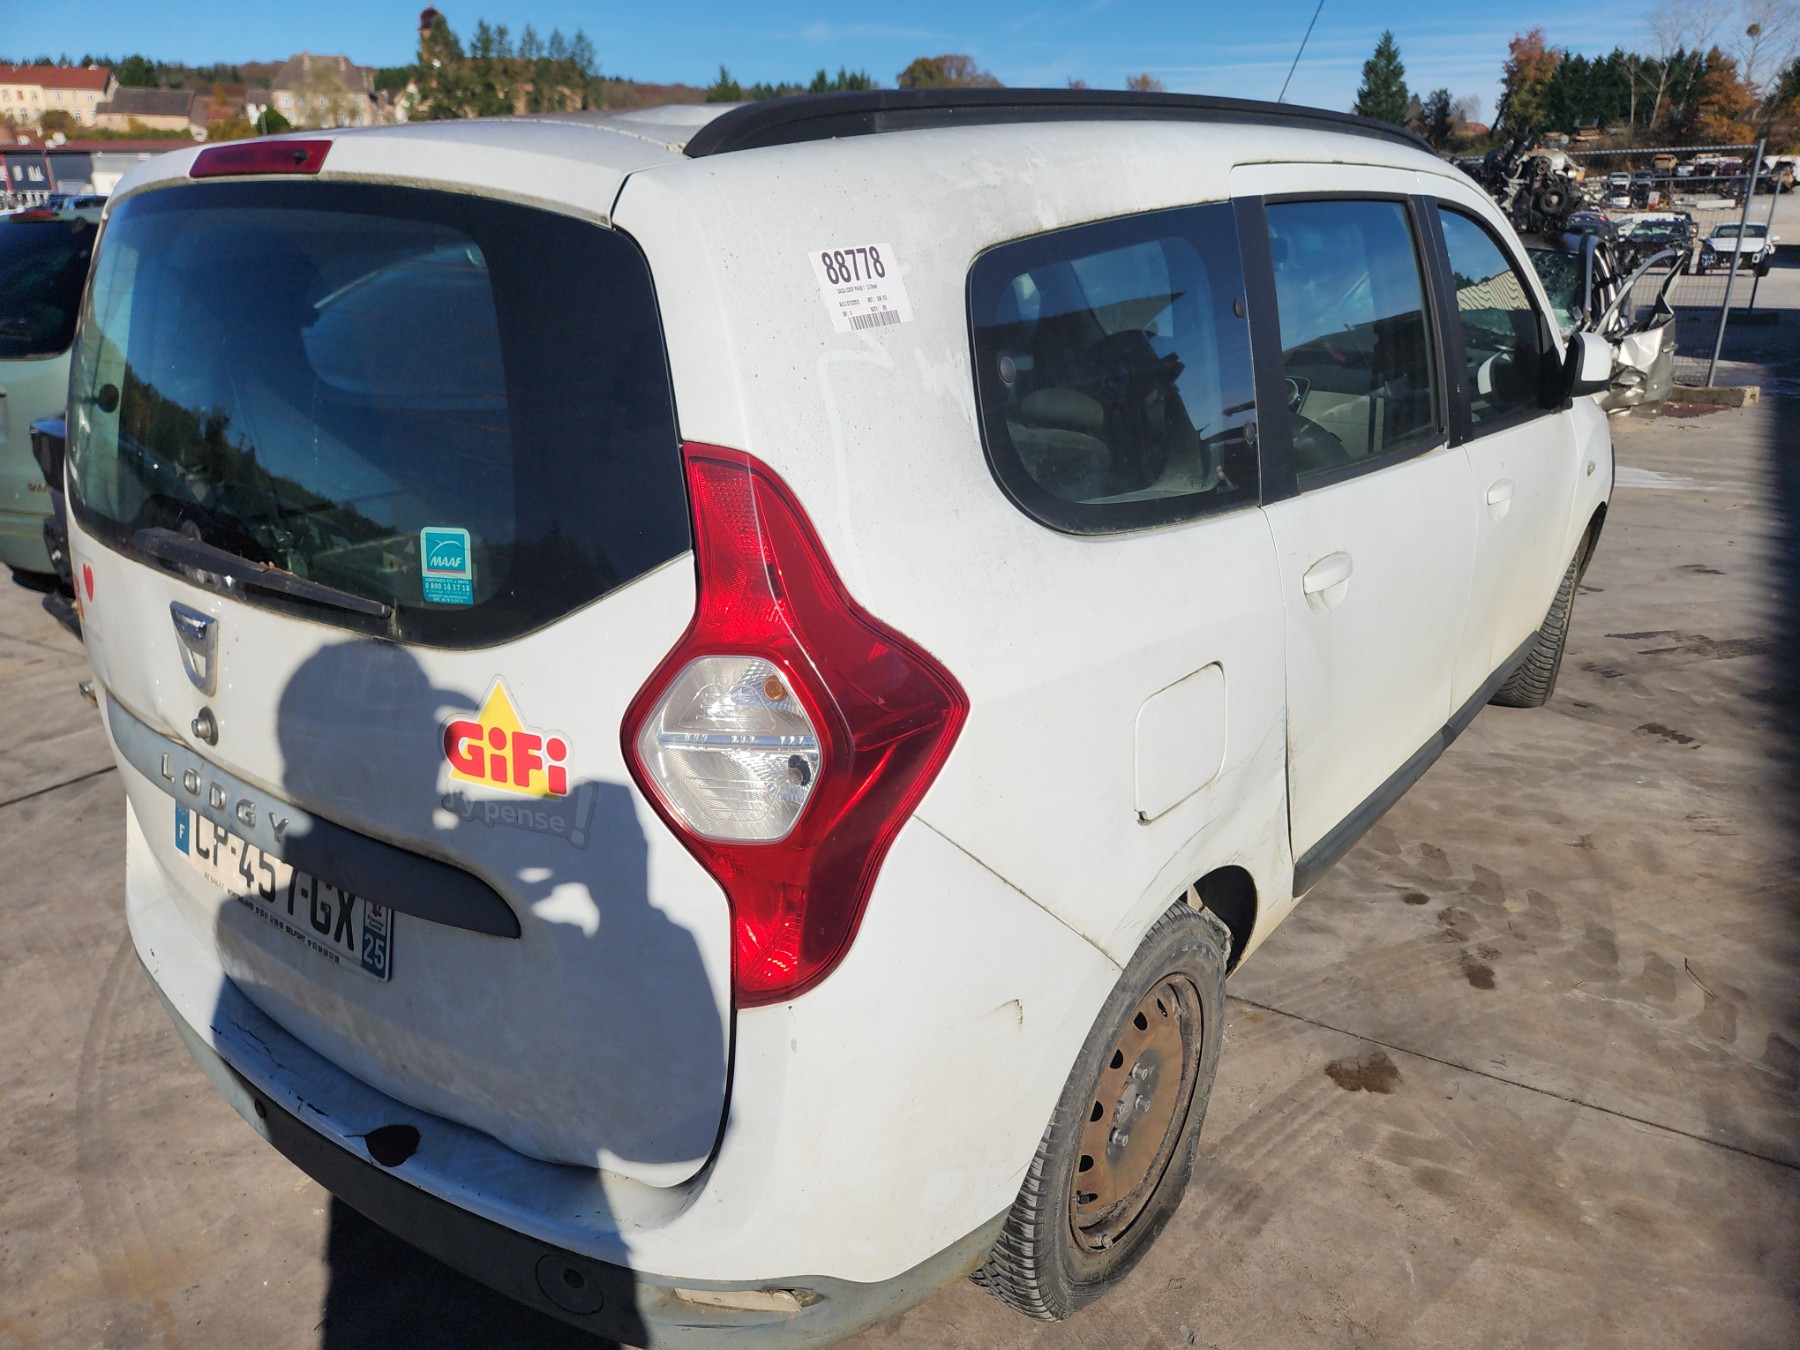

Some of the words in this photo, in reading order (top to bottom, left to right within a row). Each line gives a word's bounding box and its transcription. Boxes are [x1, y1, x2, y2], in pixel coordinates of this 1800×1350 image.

[821, 246, 886, 285] 88778
[430, 556, 462, 568] MAAF
[443, 720, 568, 796] GiFi
[161, 752, 290, 843] LODGY
[179, 823, 186, 839] F
[363, 932, 386, 971] 25
